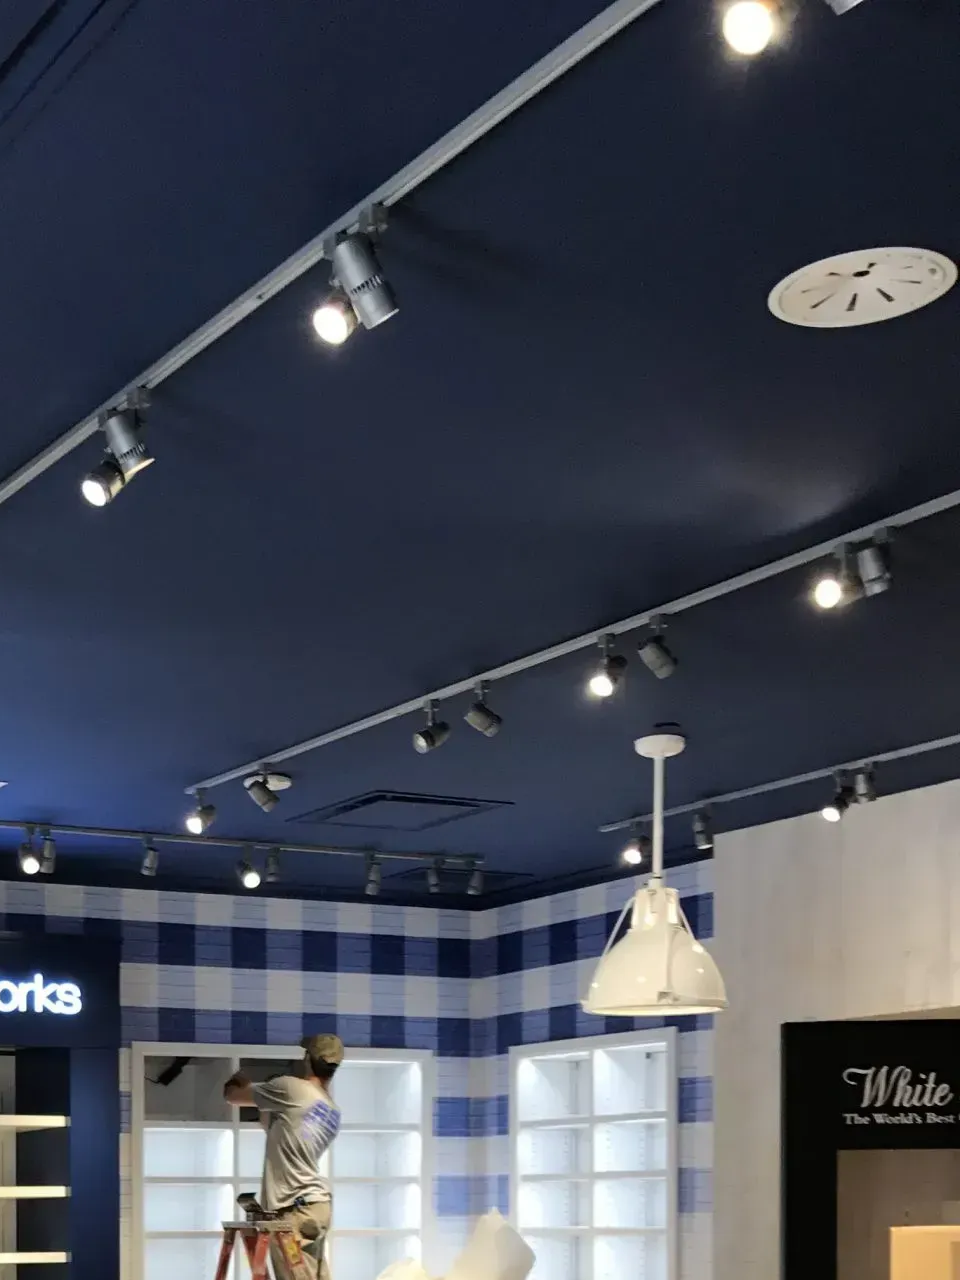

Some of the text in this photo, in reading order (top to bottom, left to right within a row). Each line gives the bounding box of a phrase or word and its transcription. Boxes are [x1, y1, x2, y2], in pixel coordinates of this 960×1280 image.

[842, 1065, 954, 1107] White
[842, 1112, 956, 1125] The World's Best
